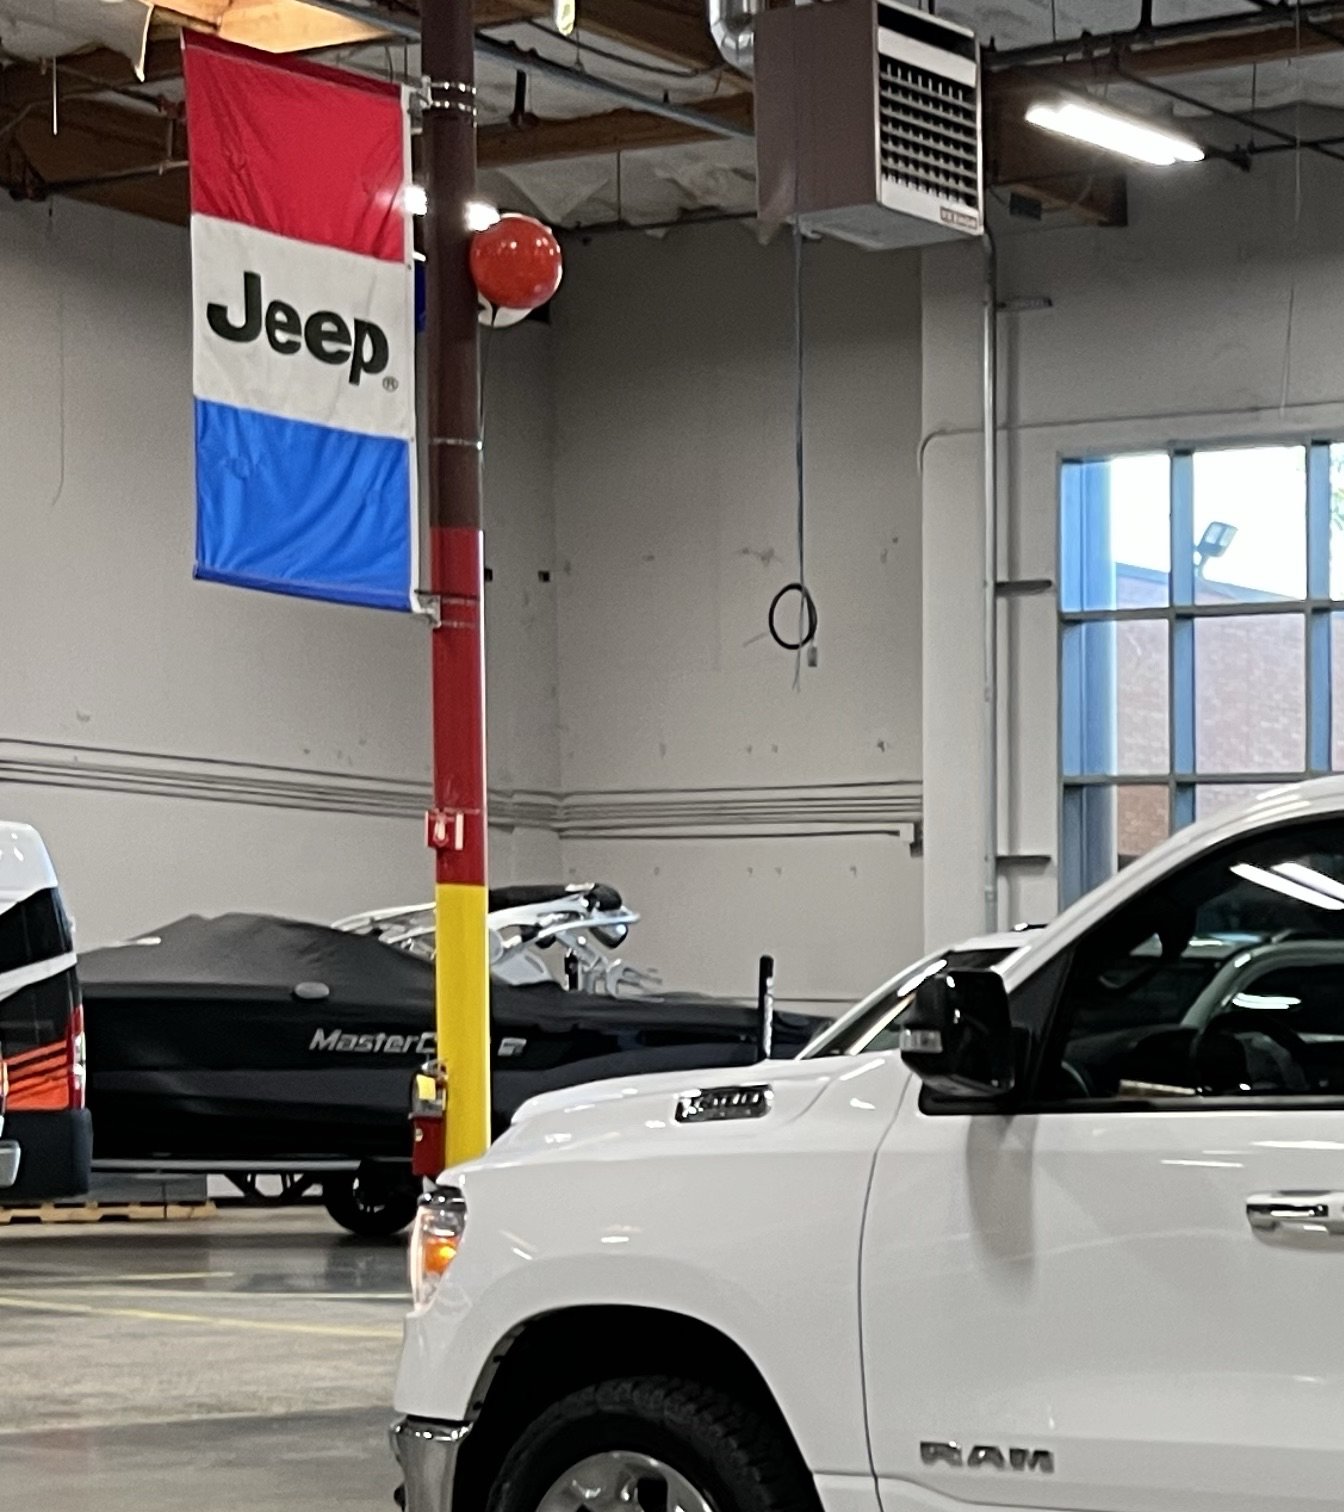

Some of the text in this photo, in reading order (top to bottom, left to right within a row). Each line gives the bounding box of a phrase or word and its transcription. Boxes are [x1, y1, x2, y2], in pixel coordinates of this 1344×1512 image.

[206, 271, 390, 386] Jeep
[308, 1027, 437, 1054] MasterC
[920, 1441, 1055, 1474] RAM
